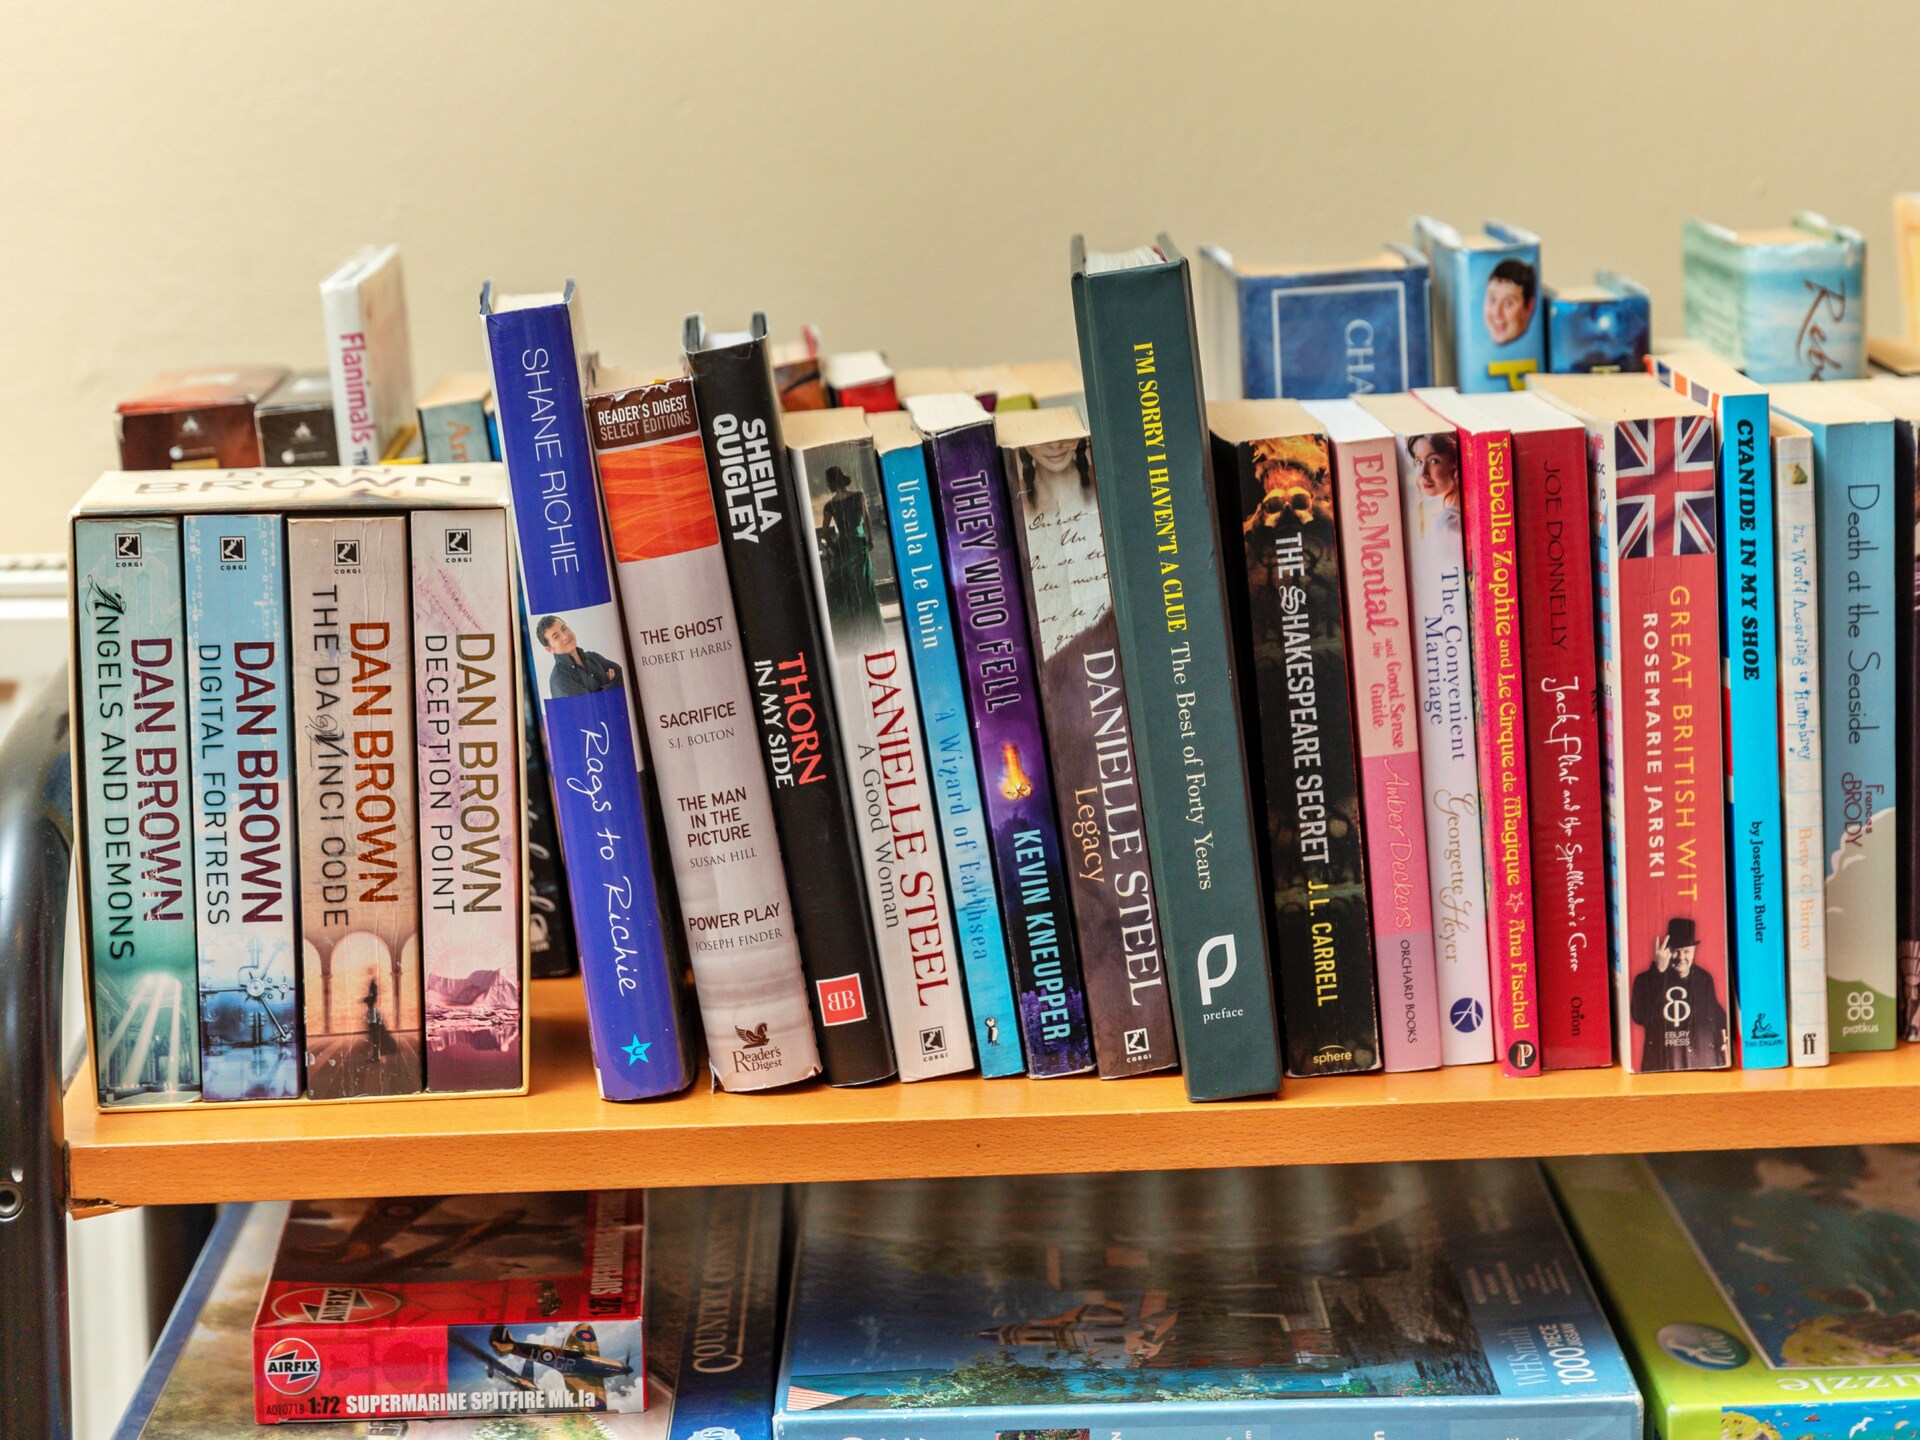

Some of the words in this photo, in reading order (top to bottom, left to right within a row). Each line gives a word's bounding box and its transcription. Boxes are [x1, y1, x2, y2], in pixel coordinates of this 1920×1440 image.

[340, 331, 377, 444] Flanimals
[1133, 341, 1156, 375] I'M
[1344, 319, 1375, 395] CHA
[522, 348, 563, 461] SHANE
[598, 404, 650, 425] READER'S
[652, 395, 688, 418] DIGEST
[601, 422, 640, 441] SELECT
[644, 411, 691, 433] EDITIONS
[1138, 379, 1166, 449] SORRY
[134, 474, 472, 495] BROWN
[712, 413, 760, 543] QUIGLEY
[742, 418, 783, 533] SHEILA
[1147, 453, 1167, 463] I
[1352, 453, 1390, 524] Ella
[1544, 460, 1562, 514] JOE
[1736, 418, 1757, 531] CYANIDE
[898, 479, 928, 556] Ursula
[950, 470, 997, 551] THEY
[1149, 467, 1178, 553] HAVEN'T
[1487, 437, 1513, 544] Isabella
[540, 470, 580, 576] RICHIE
[1740, 538, 1757, 568] IN
[1847, 484, 1880, 560] Death
[910, 563, 934, 590] Le
[1160, 561, 1181, 575] A
[1275, 532, 1305, 579] THE
[1359, 524, 1400, 636] Mental
[1546, 521, 1567, 650] DONNELLY
[1847, 570, 1872, 592] at
[312, 585, 340, 651] THE
[962, 559, 1009, 630] WHO
[1162, 578, 1188, 632] CLUE
[1441, 566, 1459, 615] The
[1488, 550, 1514, 637] Zophie
[1741, 573, 1758, 611] MY
[1847, 603, 1880, 638] the
[85, 575, 127, 718] ANGELS
[640, 628, 669, 646] THE
[674, 616, 723, 640] GHOST
[641, 650, 685, 667] ROBERT
[690, 640, 733, 659] HARRIS
[916, 599, 944, 649] Guin
[1499, 639, 1514, 667] and
[1669, 585, 1692, 689] GREAT
[1742, 615, 1760, 680] SHOE
[131, 637, 176, 733] DAN
[314, 667, 341, 711] DA
[753, 660, 777, 687] IN
[977, 639, 1021, 714] FELL
[1170, 642, 1192, 684] The
[1279, 585, 1322, 769] SHAKESPEARE
[1424, 616, 1444, 725] Marriage
[1444, 625, 1469, 761] Convenient
[1498, 673, 1516, 698] Le
[1643, 612, 1663, 774] ROSEMARIE
[198, 644, 226, 759] DIGITAL
[425, 635, 452, 809] DECEPTION
[659, 701, 737, 729] SACRIFICE
[758, 692, 784, 728] MY
[777, 651, 827, 784] THORN
[934, 708, 957, 723] A
[1176, 691, 1196, 739] Best
[1541, 676, 1580, 737] Jack
[1788, 689, 1815, 761] Humphrey
[1847, 650, 1881, 745] Seaside
[687, 728, 735, 746] BOLTON
[768, 734, 794, 789] SIDE
[857, 744, 876, 761] A
[1182, 745, 1204, 766] of
[1497, 702, 1517, 768] Cirque
[1544, 733, 1582, 786] Flint
[1673, 704, 1697, 828] BRITISH
[100, 732, 128, 801] AND
[305, 714, 349, 820] VINCI
[566, 722, 612, 812] Rags
[937, 731, 972, 815] Wizard
[1502, 771, 1517, 792] de
[677, 795, 707, 812] THE
[711, 787, 747, 806] MAN
[690, 814, 705, 829] IN
[710, 807, 742, 824] THE
[862, 769, 889, 833] Good
[864, 649, 929, 860] DANIELLE
[900, 871, 949, 1007] STEEL
[1083, 648, 1143, 860] DANIELLE
[1114, 870, 1162, 1007] STEEL
[1185, 772, 1207, 825] Forty
[1296, 774, 1330, 864] SECRET
[1384, 759, 1412, 837] Amber
[1750, 821, 1763, 837] by
[1841, 771, 1863, 848] BRODY
[1865, 784, 1885, 834] Frances
[136, 747, 184, 921] BROWN
[203, 772, 230, 925] FORTRESS
[596, 828, 621, 860] to
[687, 823, 752, 848] PICTURE
[689, 854, 727, 868] SUSAN
[730, 847, 758, 864] HILL
[954, 826, 977, 849] of
[1072, 786, 1105, 883] Legacy
[1194, 831, 1215, 890] Years
[1433, 788, 1477, 895] Georgette
[1501, 796, 1522, 885] Magique
[1644, 784, 1665, 878] JARSKI
[104, 817, 135, 960] DEMONS
[321, 836, 350, 927] CODE
[430, 825, 455, 915] POINT
[874, 841, 900, 929] Woman
[1013, 829, 1051, 905] KEVIN
[1390, 839, 1415, 929] Deckers
[1556, 843, 1586, 927] Spellbinder's
[1676, 838, 1699, 901] WIT
[1750, 839, 1766, 901] Josephine
[603, 876, 638, 997] Richie
[688, 914, 740, 932] POWER
[744, 902, 780, 926] PLAY
[695, 938, 735, 953] JOSEPH
[739, 928, 783, 946] FINDER
[959, 861, 988, 960] Earthsea
[1439, 886, 1472, 963] Heyer
[1754, 904, 1766, 943] Butler
[1026, 912, 1071, 1041] KNEUPPER
[1311, 922, 1339, 1007] CARRELL
[1400, 939, 1415, 1000] ORCHARD
[1512, 961, 1530, 1030] Fischel
[1203, 1007, 1244, 1024] preface
[1406, 1002, 1417, 1044] BOOKS
[1570, 996, 1585, 1038] Orion
[1664, 1030, 1691, 1039] EBURY
[1664, 1038, 1691, 1047] PRESS
[1842, 1023, 1880, 1037] piatkus
[732, 1046, 782, 1072] Reader's
[752, 1058, 782, 1071] Digest
[923, 1053, 949, 1062] CORGI
[1126, 1054, 1152, 1063] CORGI
[1313, 1050, 1353, 1065] sphere
[320, 1288, 353, 1321] AIRFIX
[1538, 1323, 1563, 1348] PIECE
[267, 1360, 319, 1373] AIRFIX
[1498, 1326, 1550, 1386] WHSmith
[1548, 1347, 1598, 1385] 1000
[308, 1395, 341, 1414] 1:72
[345, 1392, 467, 1414] SUPERMARINE
[470, 1390, 545, 1411] SPITFIRE
[548, 1388, 596, 1409] Mk.Ia
